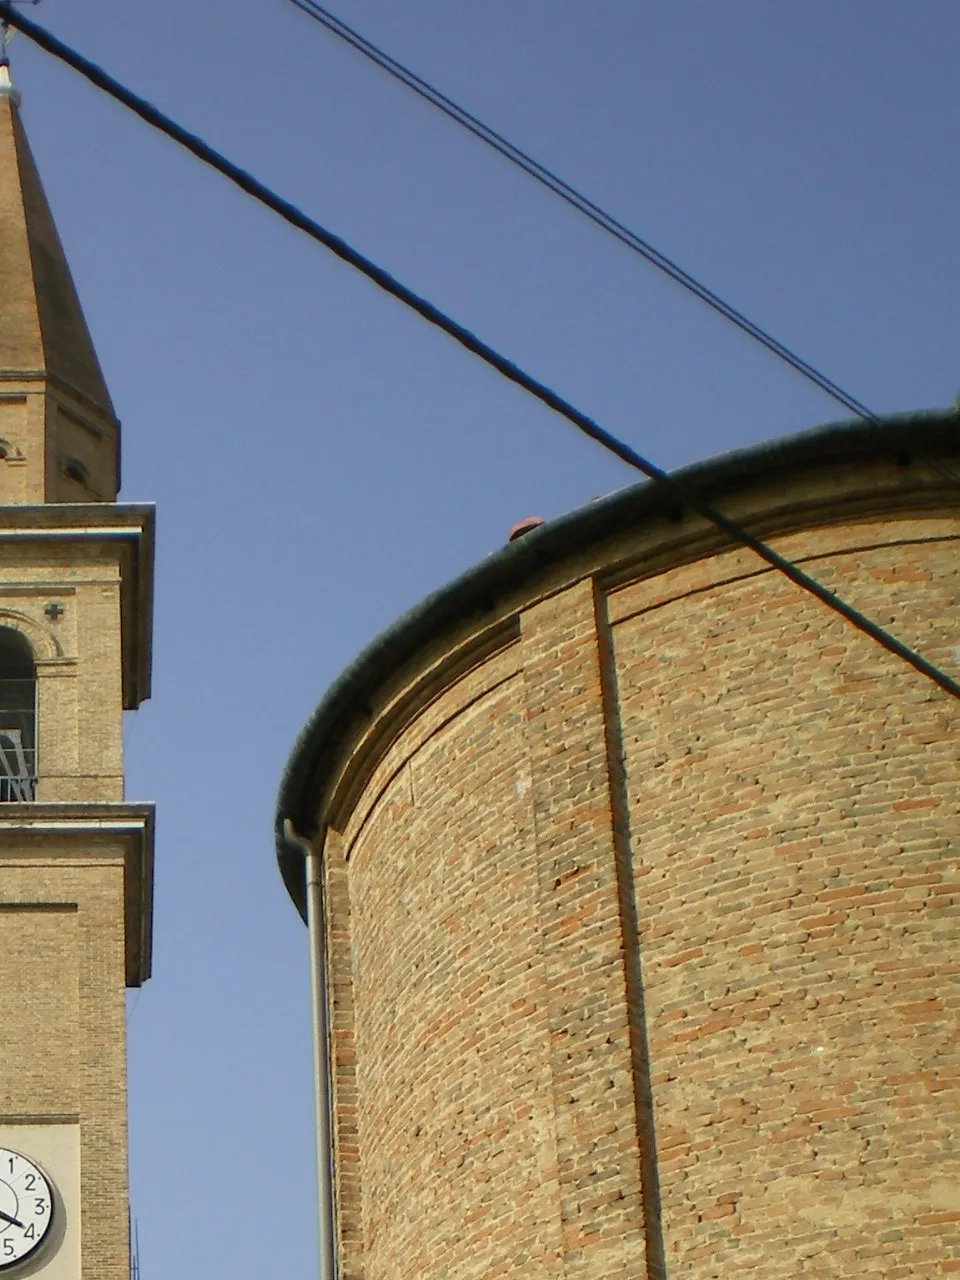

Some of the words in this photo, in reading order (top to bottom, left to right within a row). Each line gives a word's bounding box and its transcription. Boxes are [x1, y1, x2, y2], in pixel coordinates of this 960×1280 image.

[8, 1158, 14, 1174] 1
[25, 1174, 36, 1191] 2
[34, 1198, 45, 1215] 3
[24, 1223, 35, 1240] 4
[3, 1238, 14, 1256] 5
